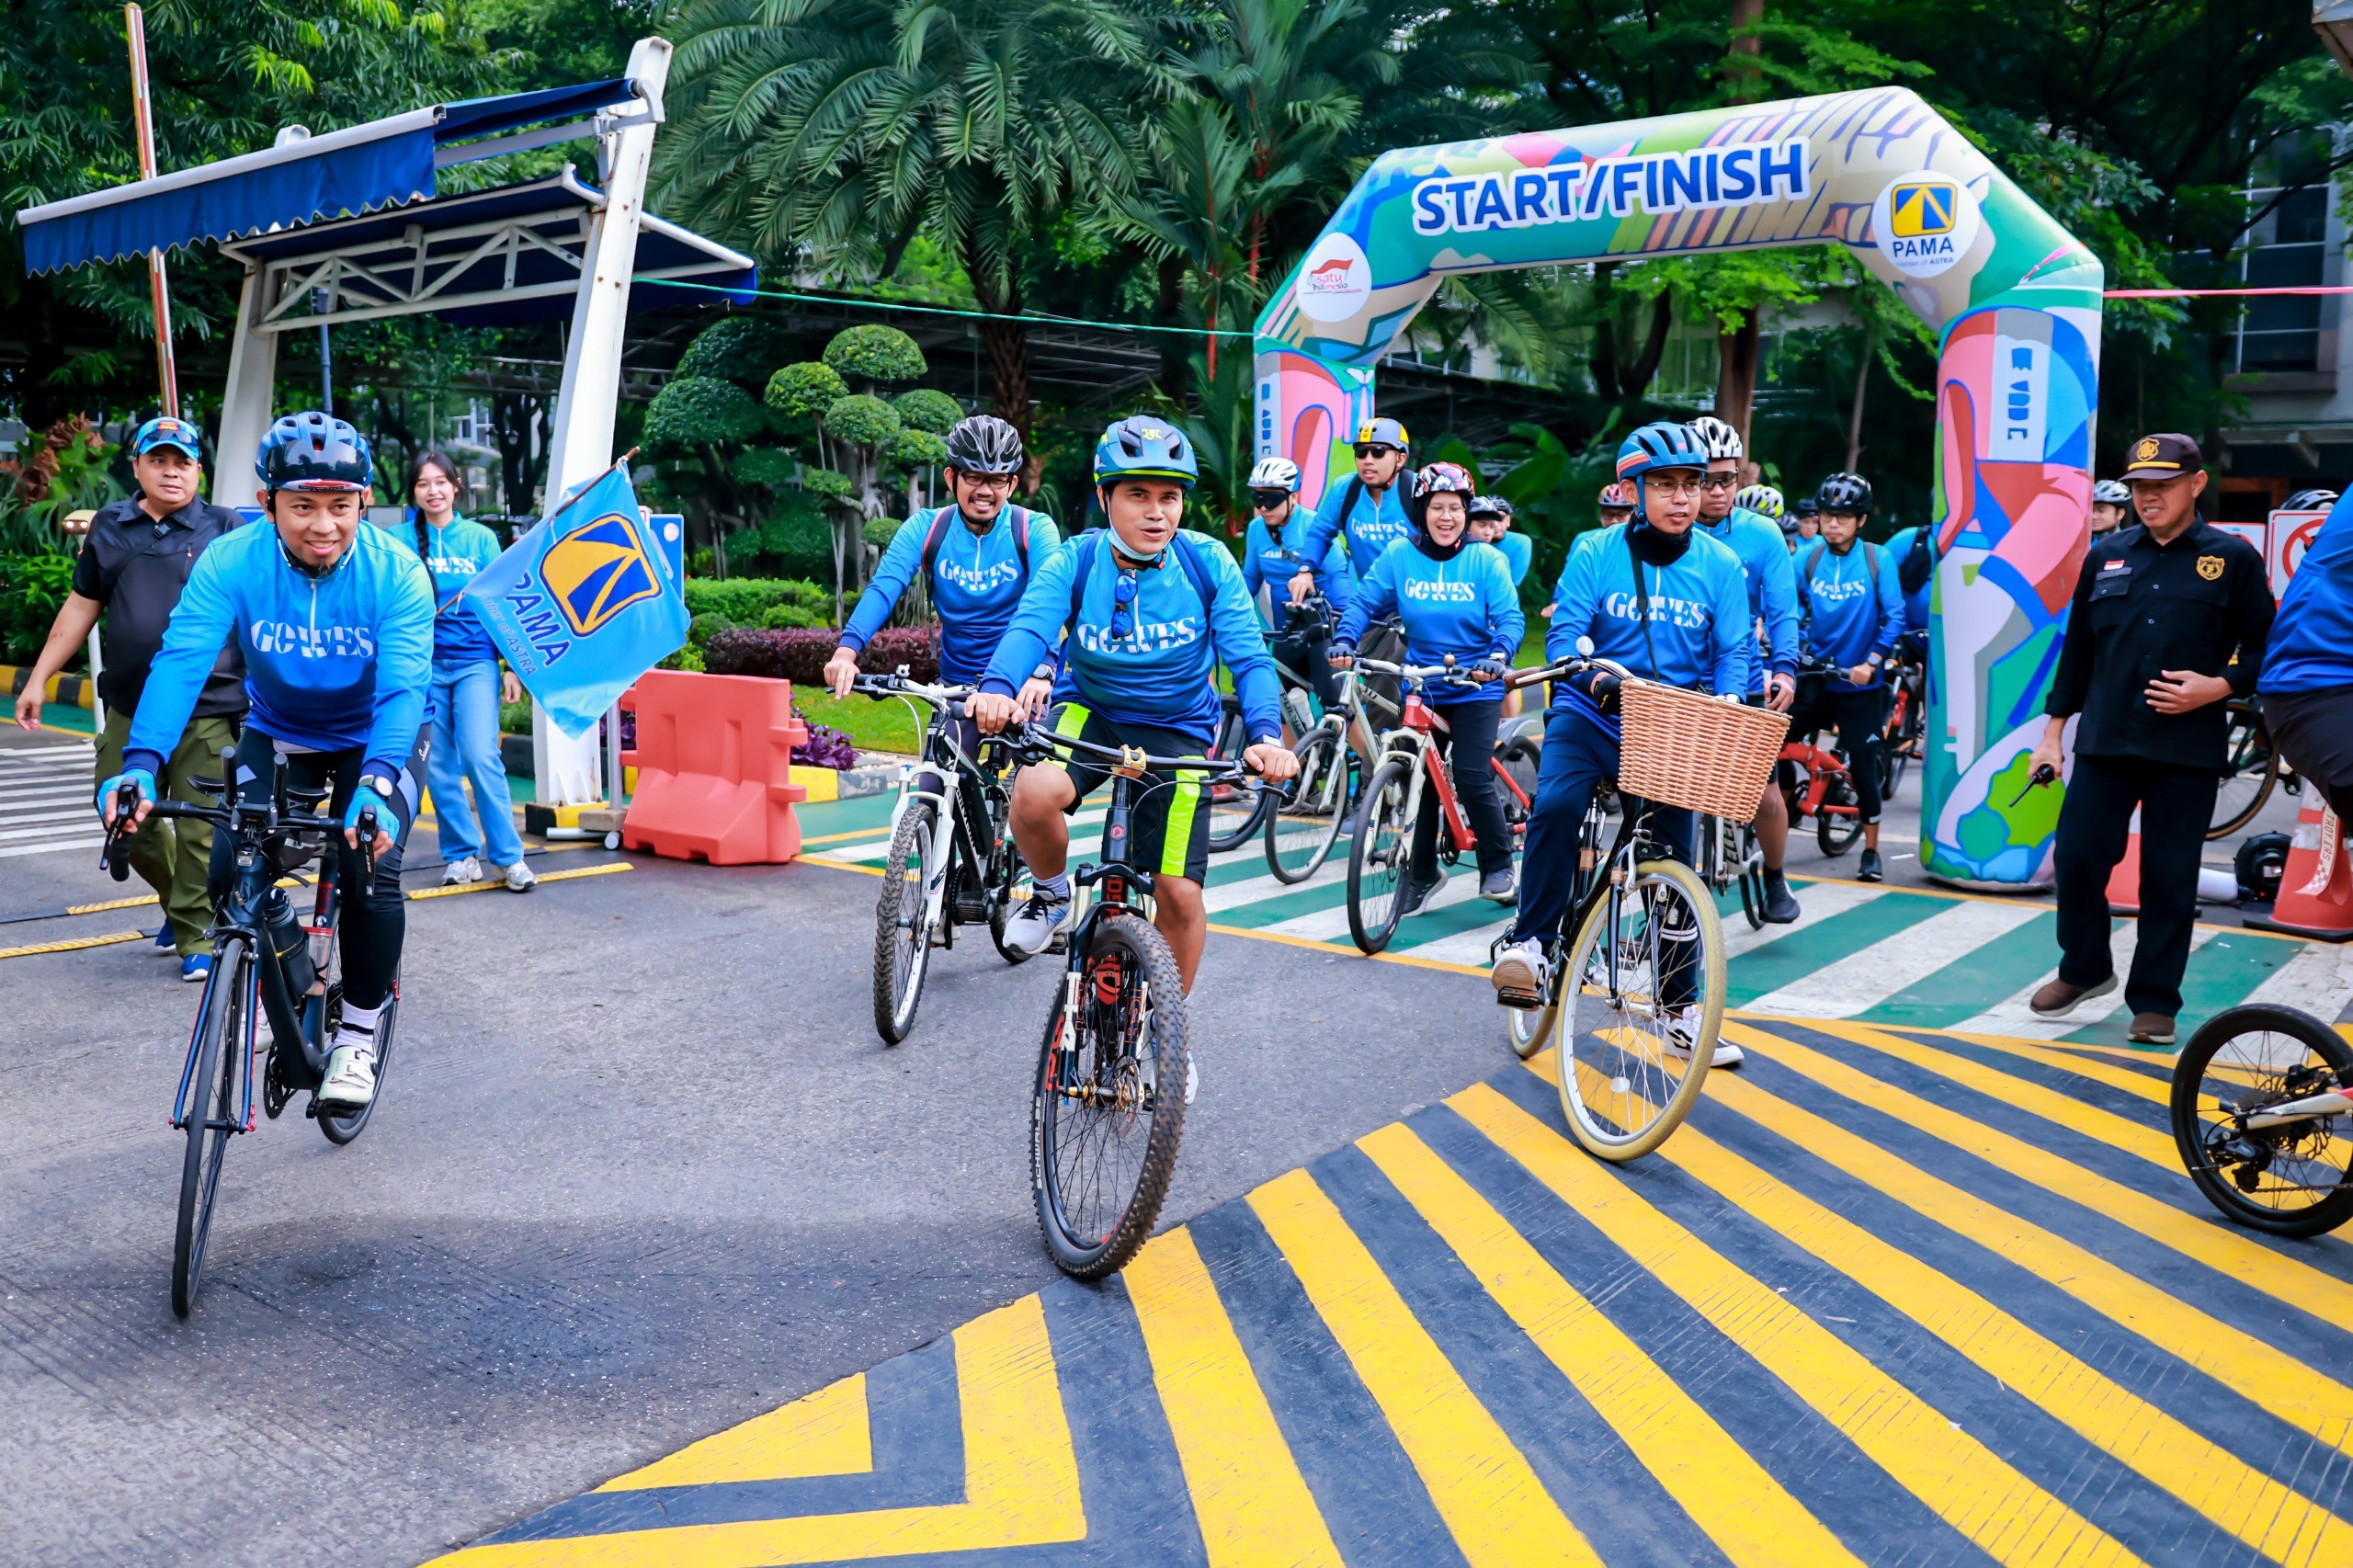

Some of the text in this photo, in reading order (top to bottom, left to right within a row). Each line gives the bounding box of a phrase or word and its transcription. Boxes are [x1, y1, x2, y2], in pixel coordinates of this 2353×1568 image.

[1893, 236, 1954, 257] PAMA
[1929, 257, 1954, 266] ASTRA
[939, 559, 1018, 591] GOWES
[1404, 577, 1475, 602] GOWES
[251, 619, 373, 658] GOWES
[506, 638, 537, 676] ASTRA
